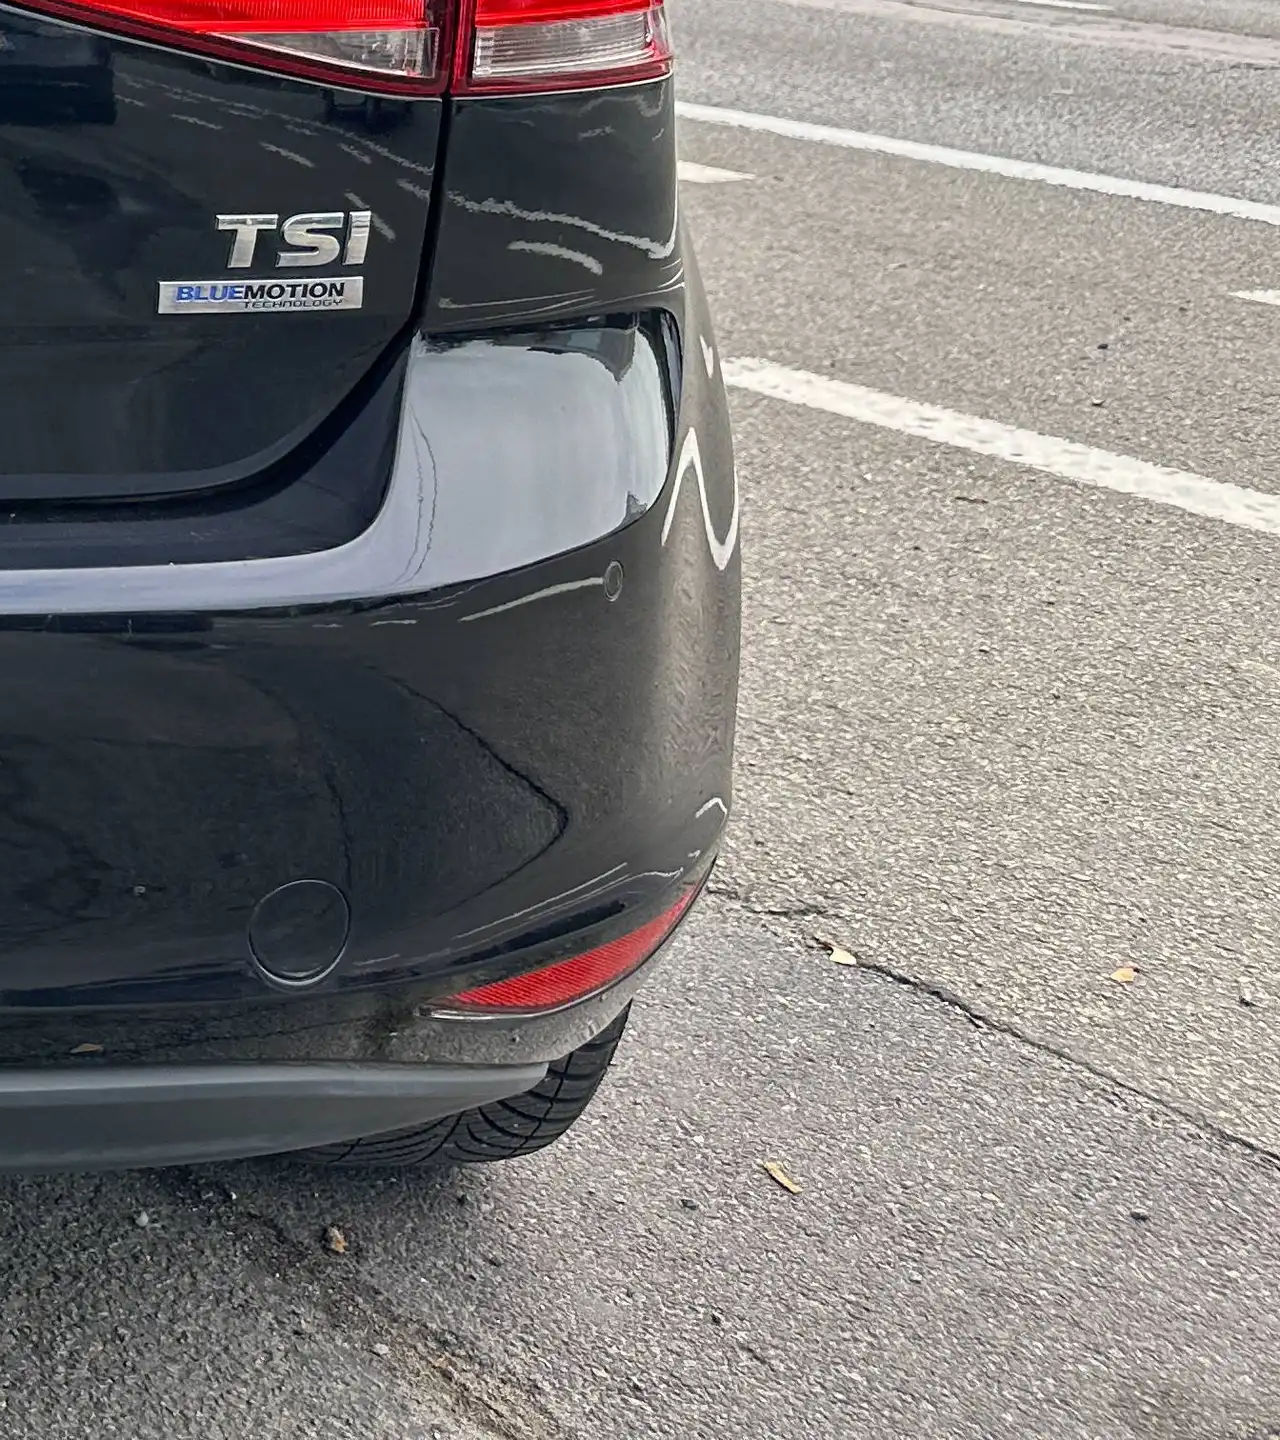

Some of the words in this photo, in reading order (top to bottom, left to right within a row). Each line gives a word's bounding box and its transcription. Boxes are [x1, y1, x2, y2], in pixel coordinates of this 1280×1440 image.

[215, 210, 371, 269] TSI
[174, 281, 345, 302] BLUEMOTION
[244, 298, 343, 310] TECHNOLOGY
